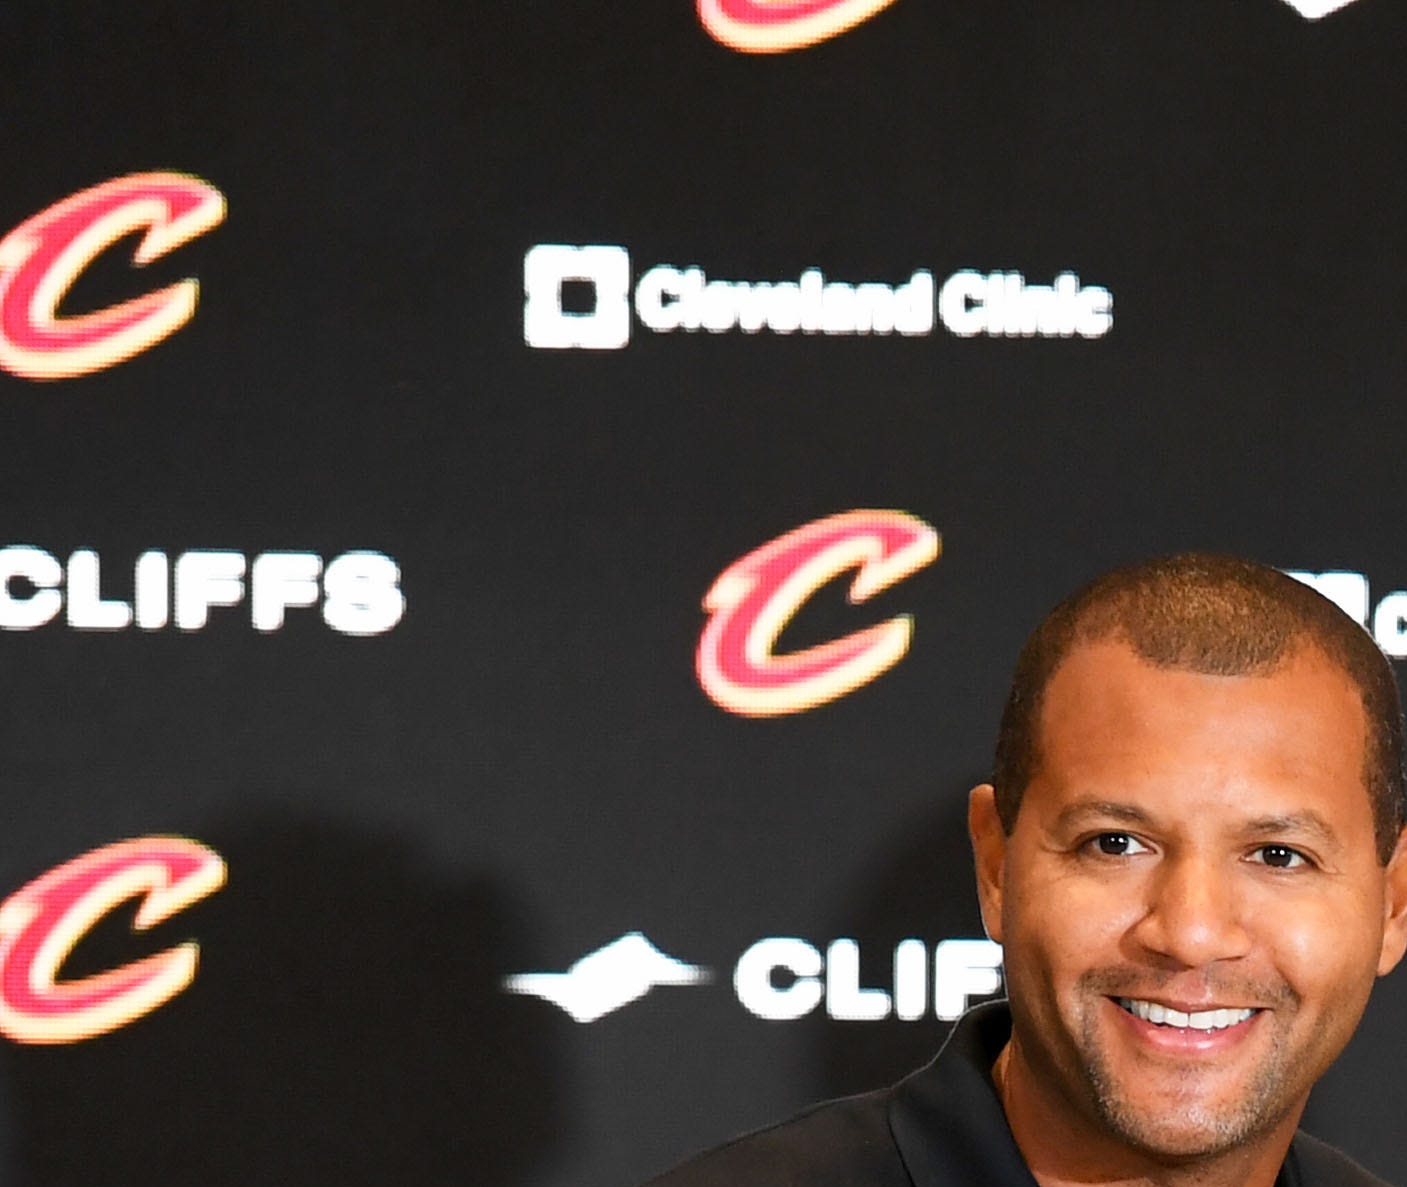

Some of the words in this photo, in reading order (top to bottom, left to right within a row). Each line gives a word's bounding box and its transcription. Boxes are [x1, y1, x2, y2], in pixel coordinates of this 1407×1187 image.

[0, 171, 227, 382] C
[636, 265, 934, 336] Cleveland
[939, 269, 1113, 338] Clinic
[0, 545, 406, 636] CLIFFS
[694, 509, 942, 718] C
[0, 834, 228, 1045] C
